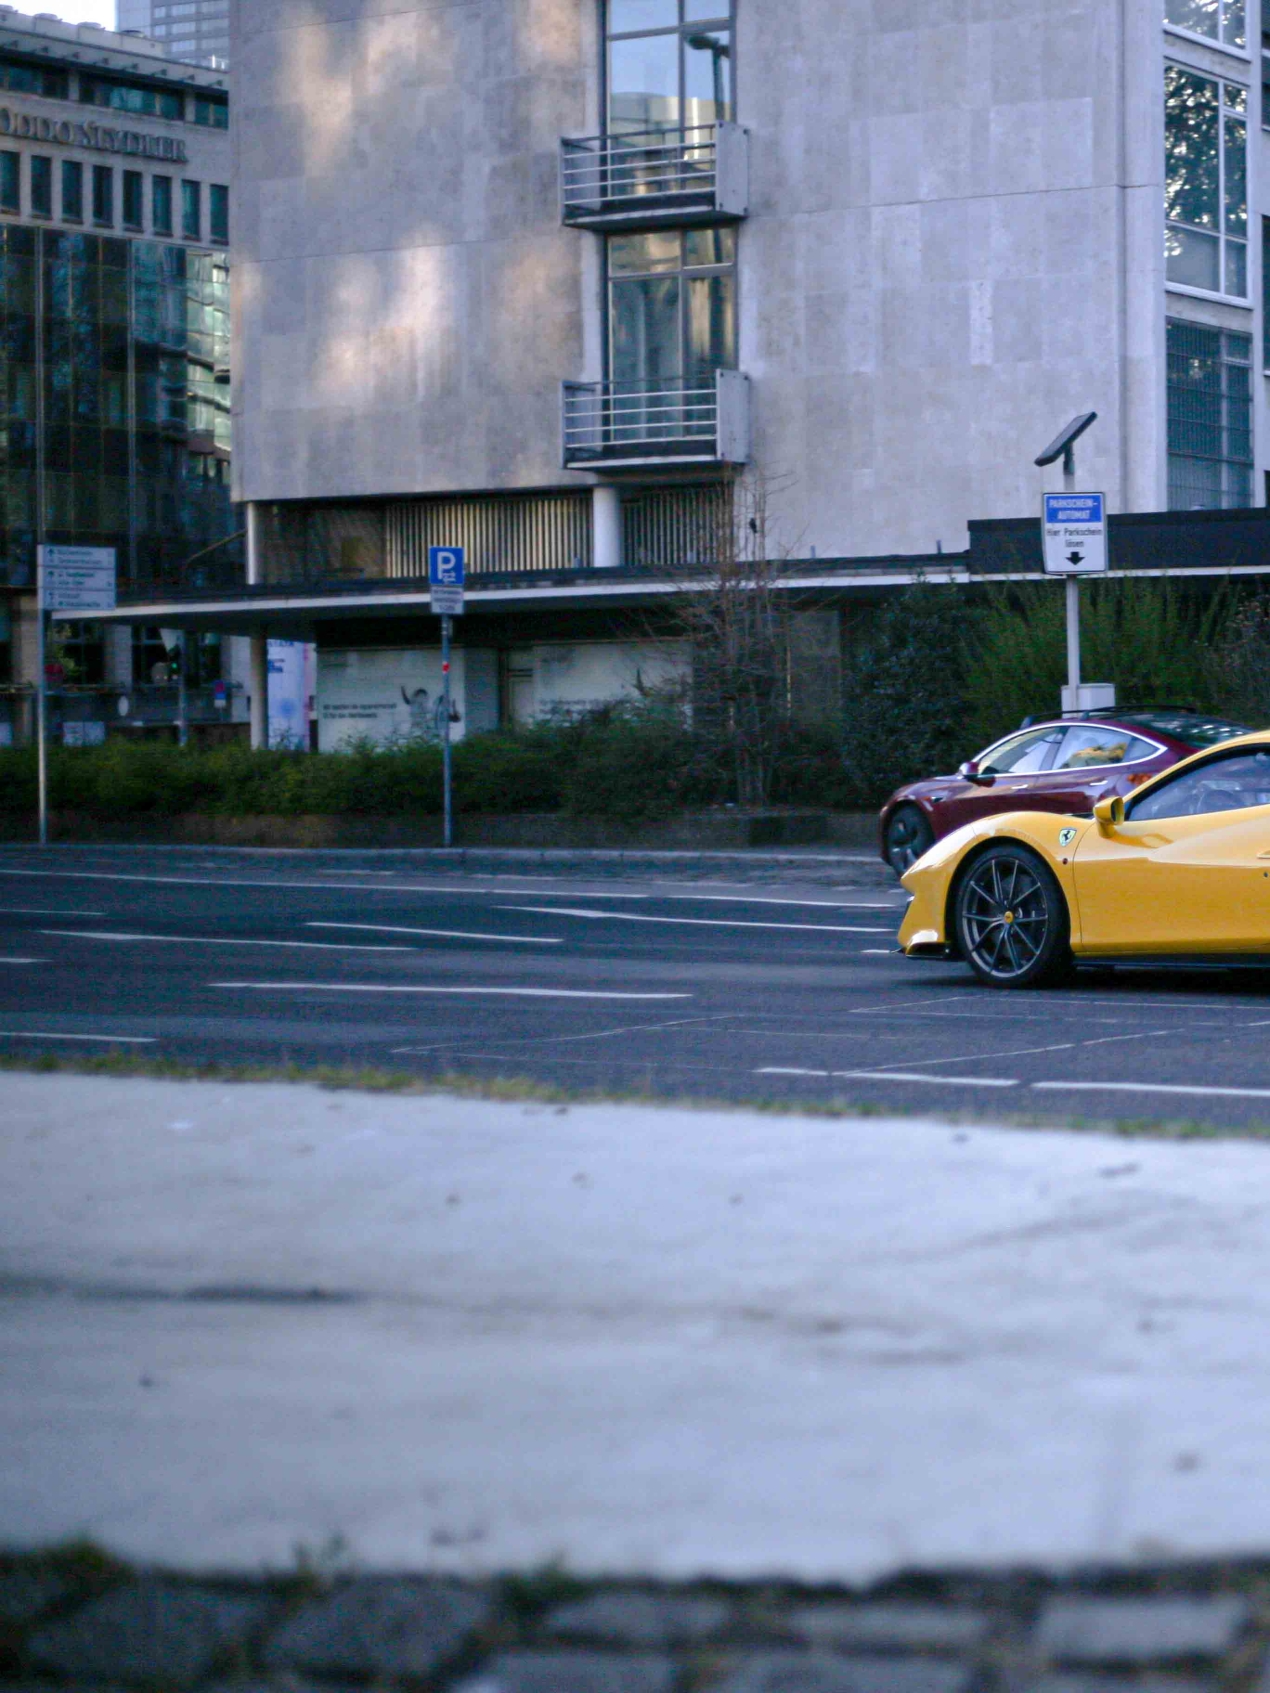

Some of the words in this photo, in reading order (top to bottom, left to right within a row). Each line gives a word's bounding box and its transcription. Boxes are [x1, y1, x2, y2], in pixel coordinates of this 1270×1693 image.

[1057, 510, 1091, 520] AUTOMAT
[1047, 527, 1061, 536] Hier
[1064, 527, 1102, 536] Parkschein
[437, 551, 456, 580] P
